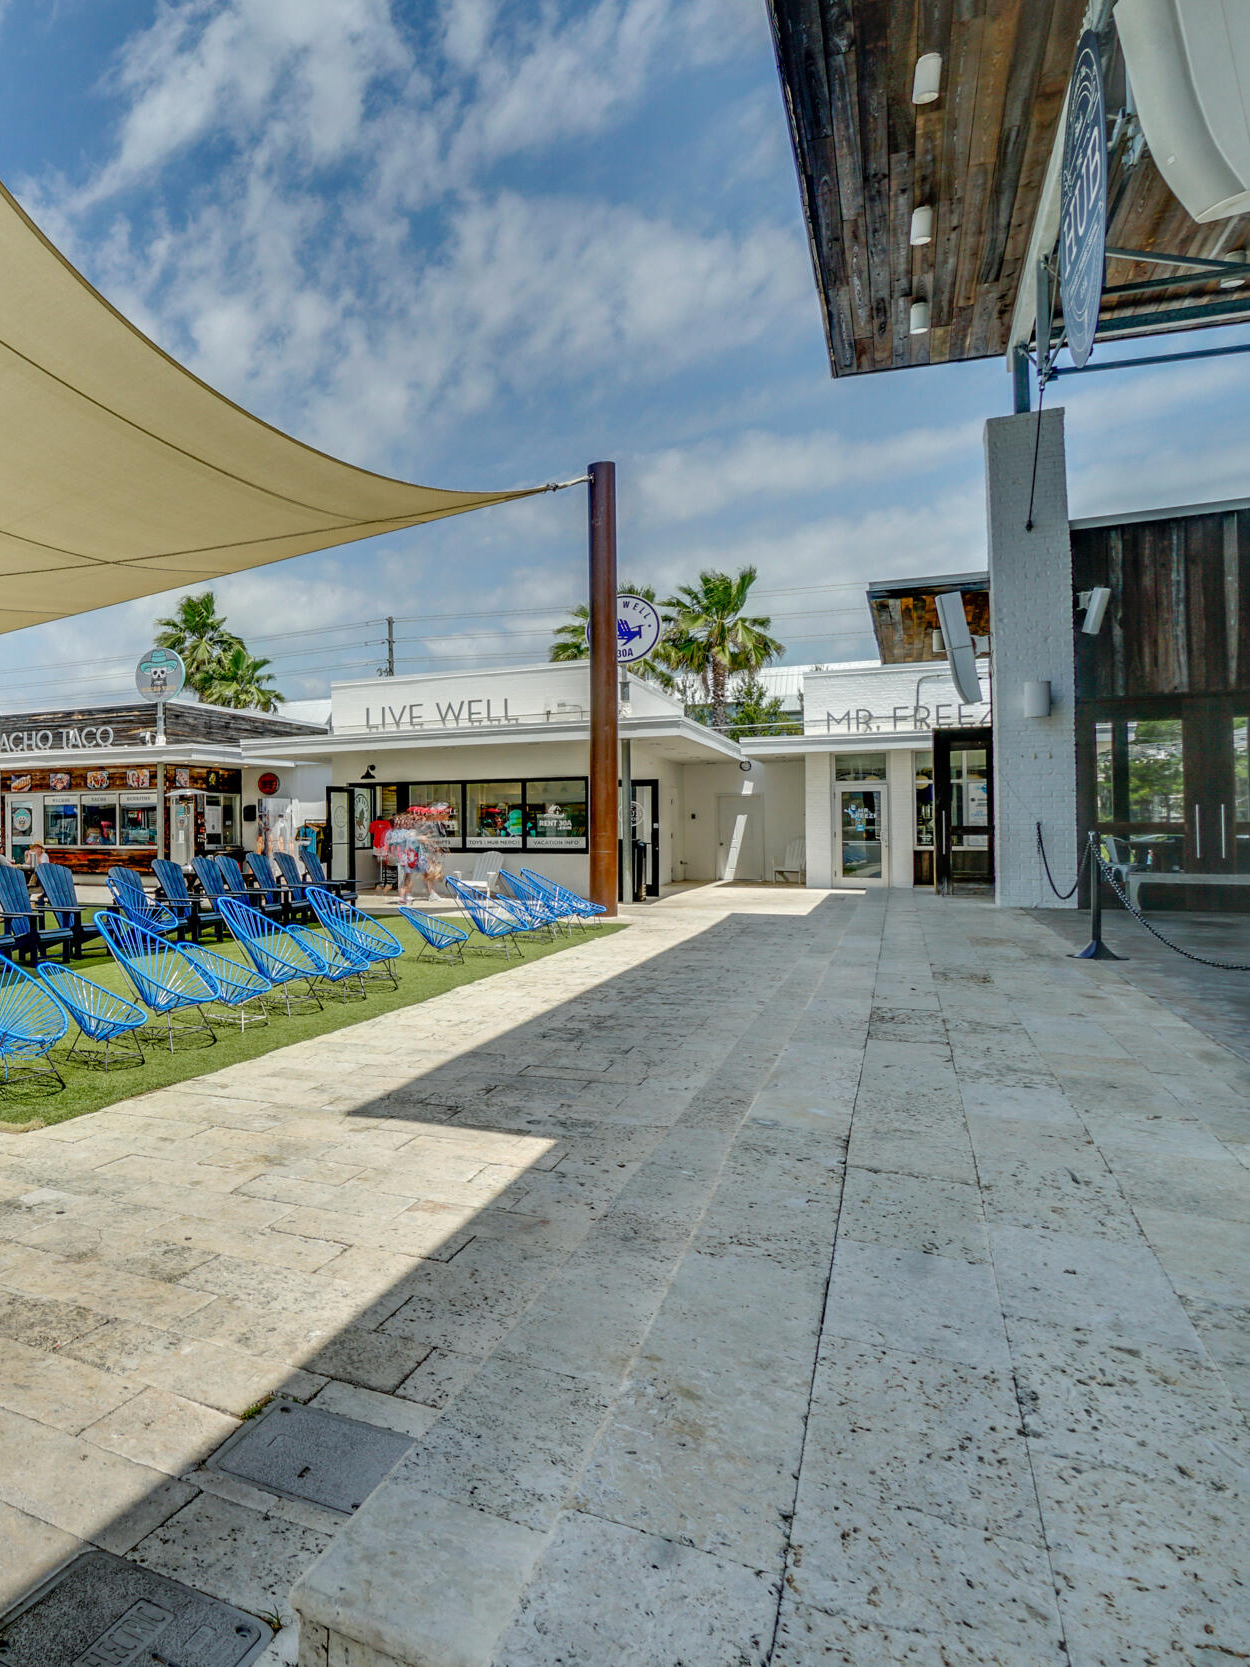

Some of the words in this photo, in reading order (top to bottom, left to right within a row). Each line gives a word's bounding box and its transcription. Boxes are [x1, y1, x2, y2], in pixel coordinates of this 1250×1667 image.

[1063, 125, 1101, 280] HUB
[623, 601, 651, 619] WELL
[617, 648, 633, 657] 30A
[366, 704, 424, 730] LIVE
[436, 698, 519, 726] WELL
[826, 709, 881, 733] MR.
[58, 726, 114, 749] TACO
